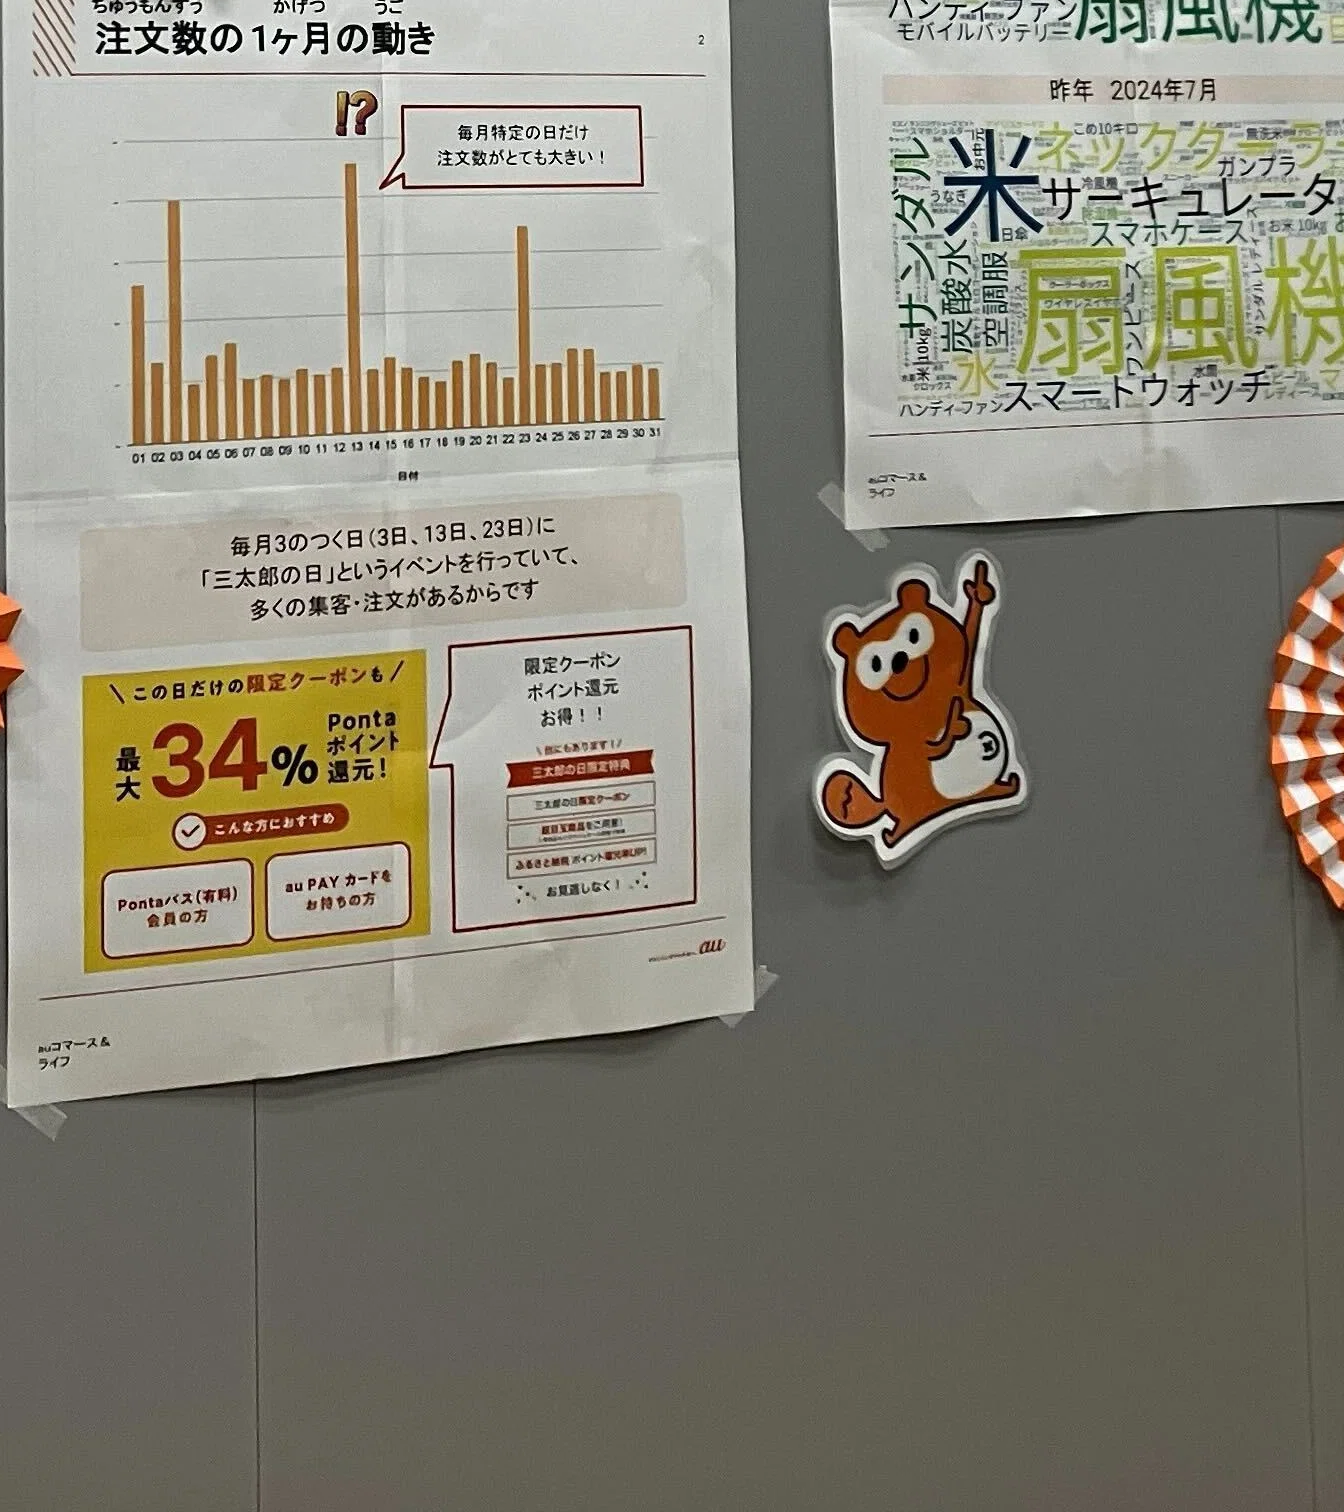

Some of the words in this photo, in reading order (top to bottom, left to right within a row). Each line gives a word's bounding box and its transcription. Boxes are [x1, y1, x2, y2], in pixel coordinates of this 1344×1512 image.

[697, 34, 705, 45] 2
[897, 22, 1069, 43] モバイルバッテリー
[1050, 79, 1094, 102] 昨年
[1110, 78, 1216, 102] 2024年7月
[457, 123, 589, 142] 毎月特定の日だけ
[1218, 155, 1295, 177] ガンプラ
[931, 189, 968, 203] うなぎ
[944, 129, 1044, 242] 米
[893, 137, 938, 338] サンダル
[1091, 220, 1248, 247] スマホケース
[939, 239, 972, 353] 炭酸水
[982, 251, 1009, 347] 空調服
[956, 351, 1000, 398] 水
[1004, 370, 1271, 412] スマートウォッチ
[524, 651, 621, 675] 限定クーポン
[328, 711, 396, 732] Ponta
[327, 732, 399, 756] ポイント
[214, 813, 336, 836] こんな方におすすめ
[285, 880, 303, 893] au
[308, 875, 340, 891] PAY
[699, 939, 726, 954] au
[38, 1056, 70, 1071] ライフ
